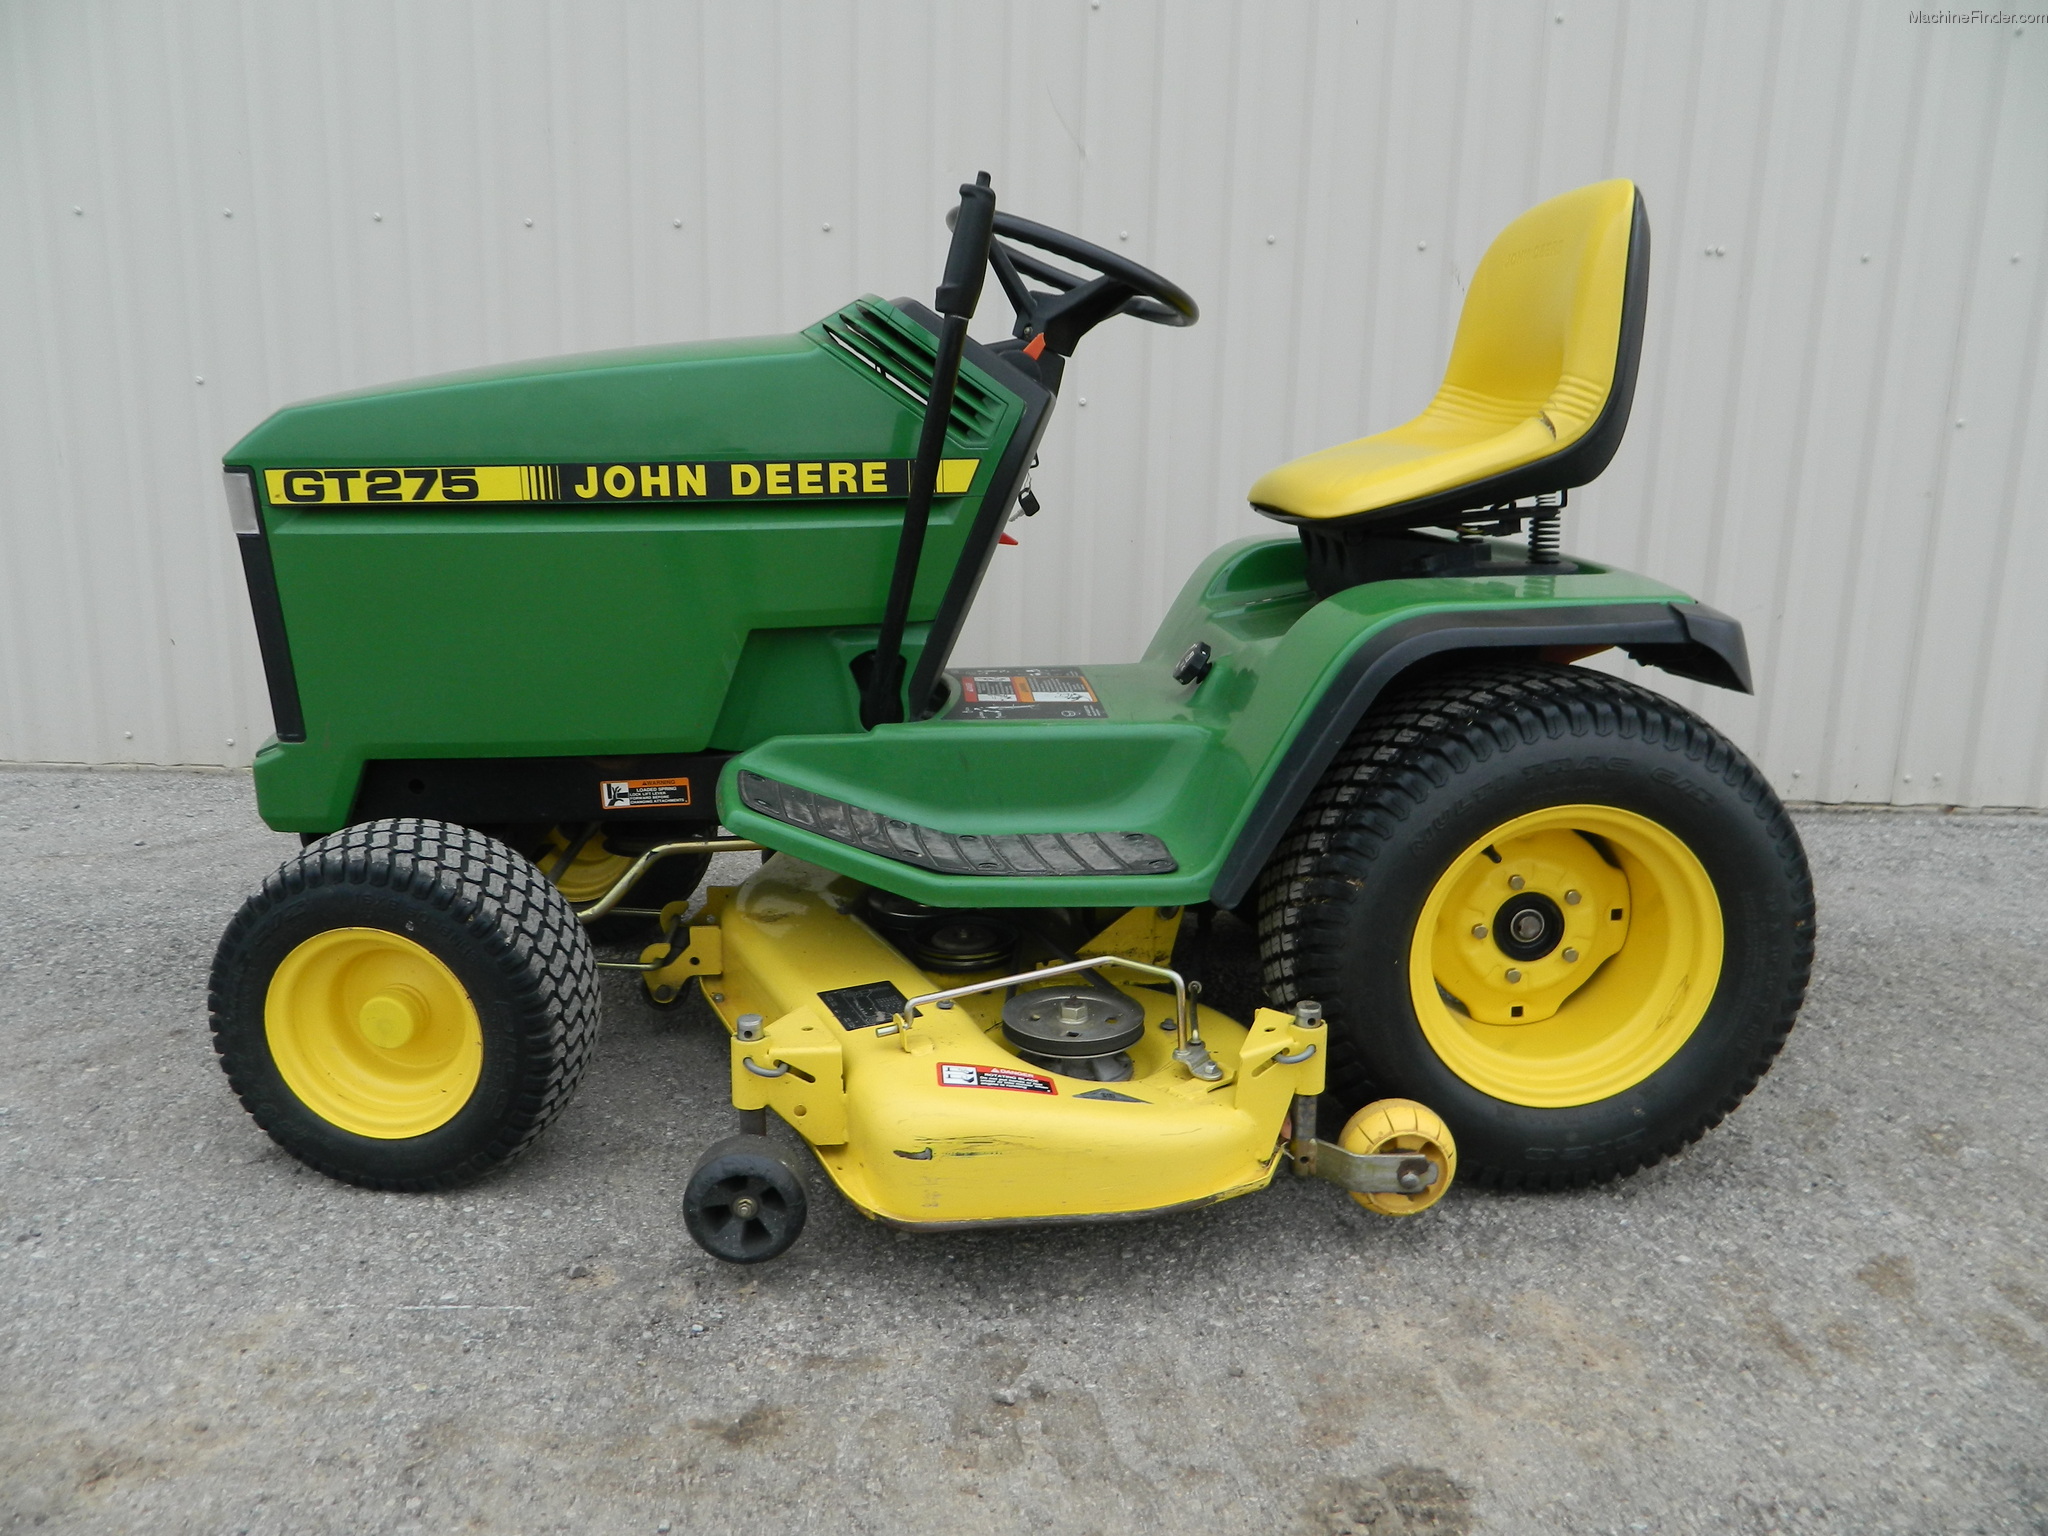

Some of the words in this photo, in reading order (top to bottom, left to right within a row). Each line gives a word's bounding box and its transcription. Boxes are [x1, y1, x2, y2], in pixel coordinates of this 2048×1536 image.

[283, 468, 479, 502] GT275
[575, 464, 707, 499] JOHN
[730, 461, 888, 496] DEERE
[1000, 1069, 1035, 1078] DANGER
